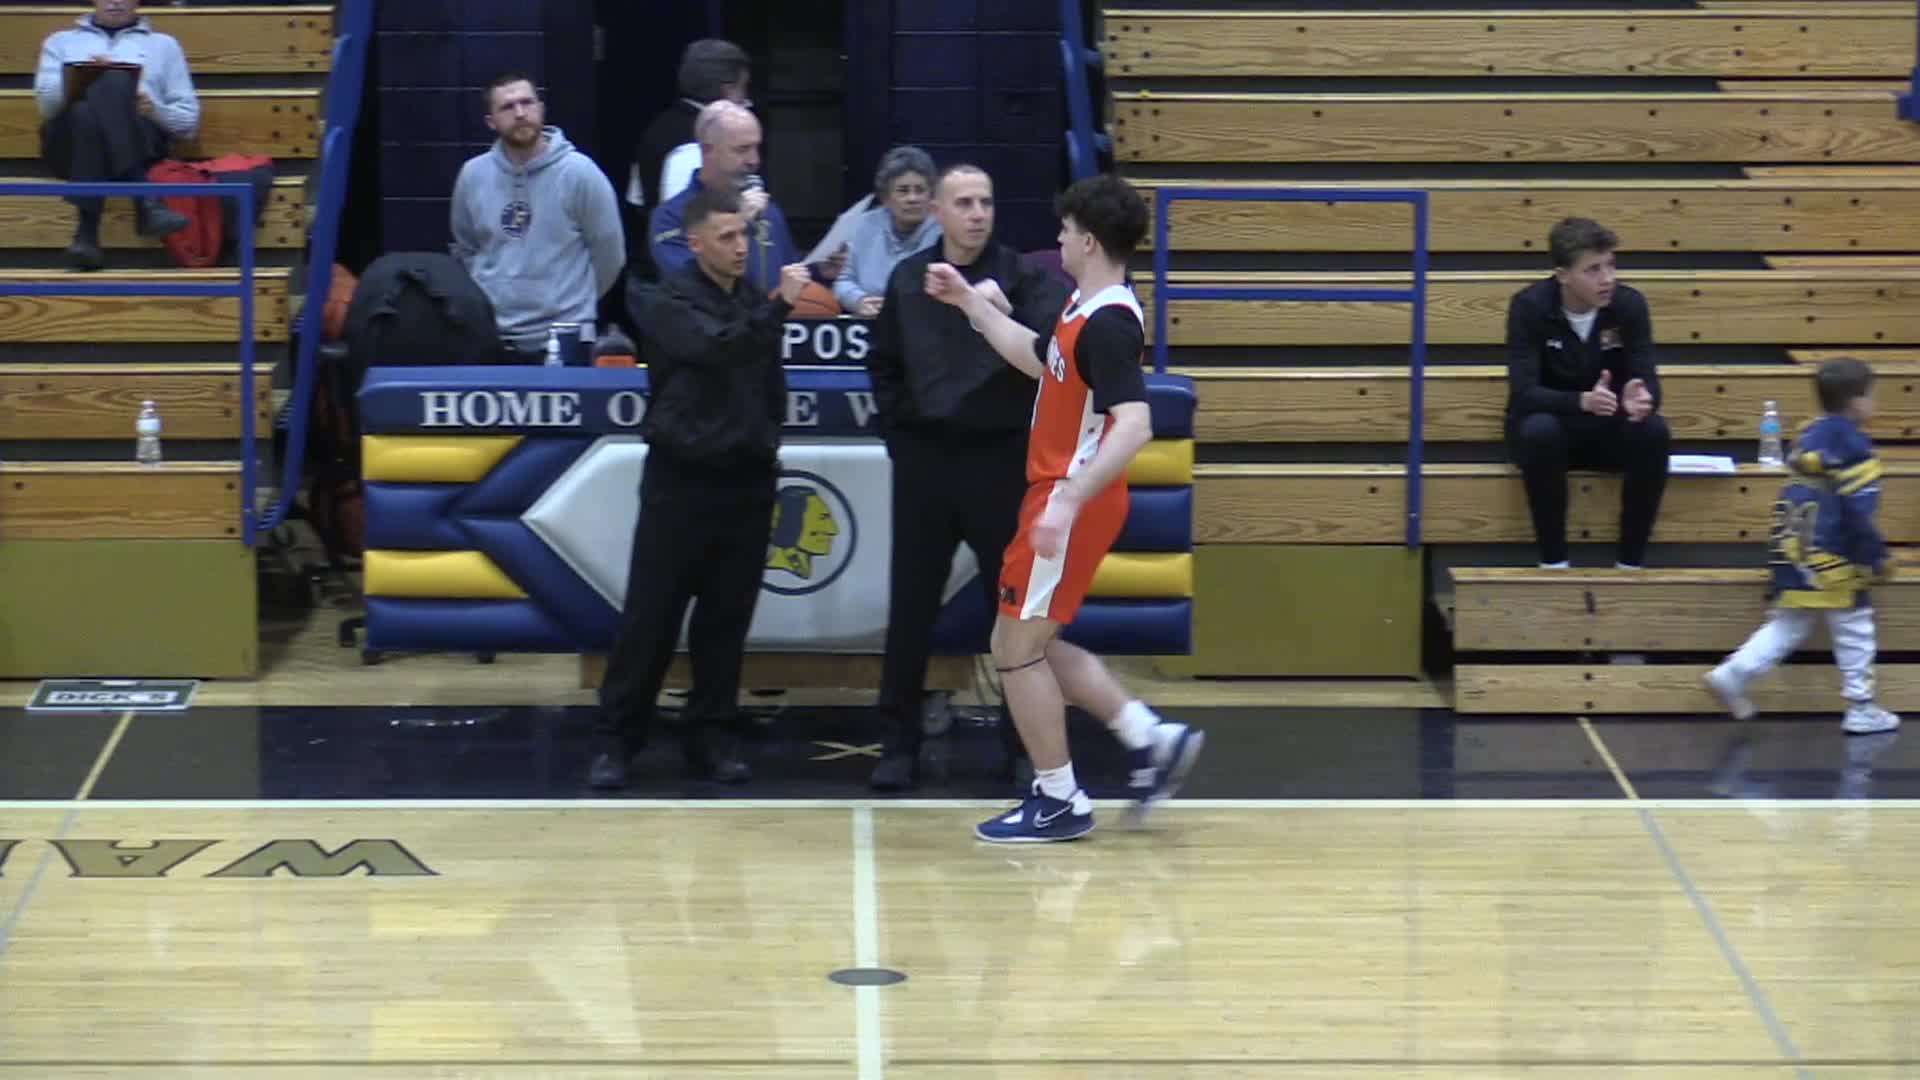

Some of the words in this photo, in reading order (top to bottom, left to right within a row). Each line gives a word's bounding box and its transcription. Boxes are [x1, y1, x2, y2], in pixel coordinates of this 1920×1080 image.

[419, 390, 582, 427] HOME
[606, 390, 649, 427] O
[55, 691, 168, 702] DICKS
[0, 838, 440, 877] WA
